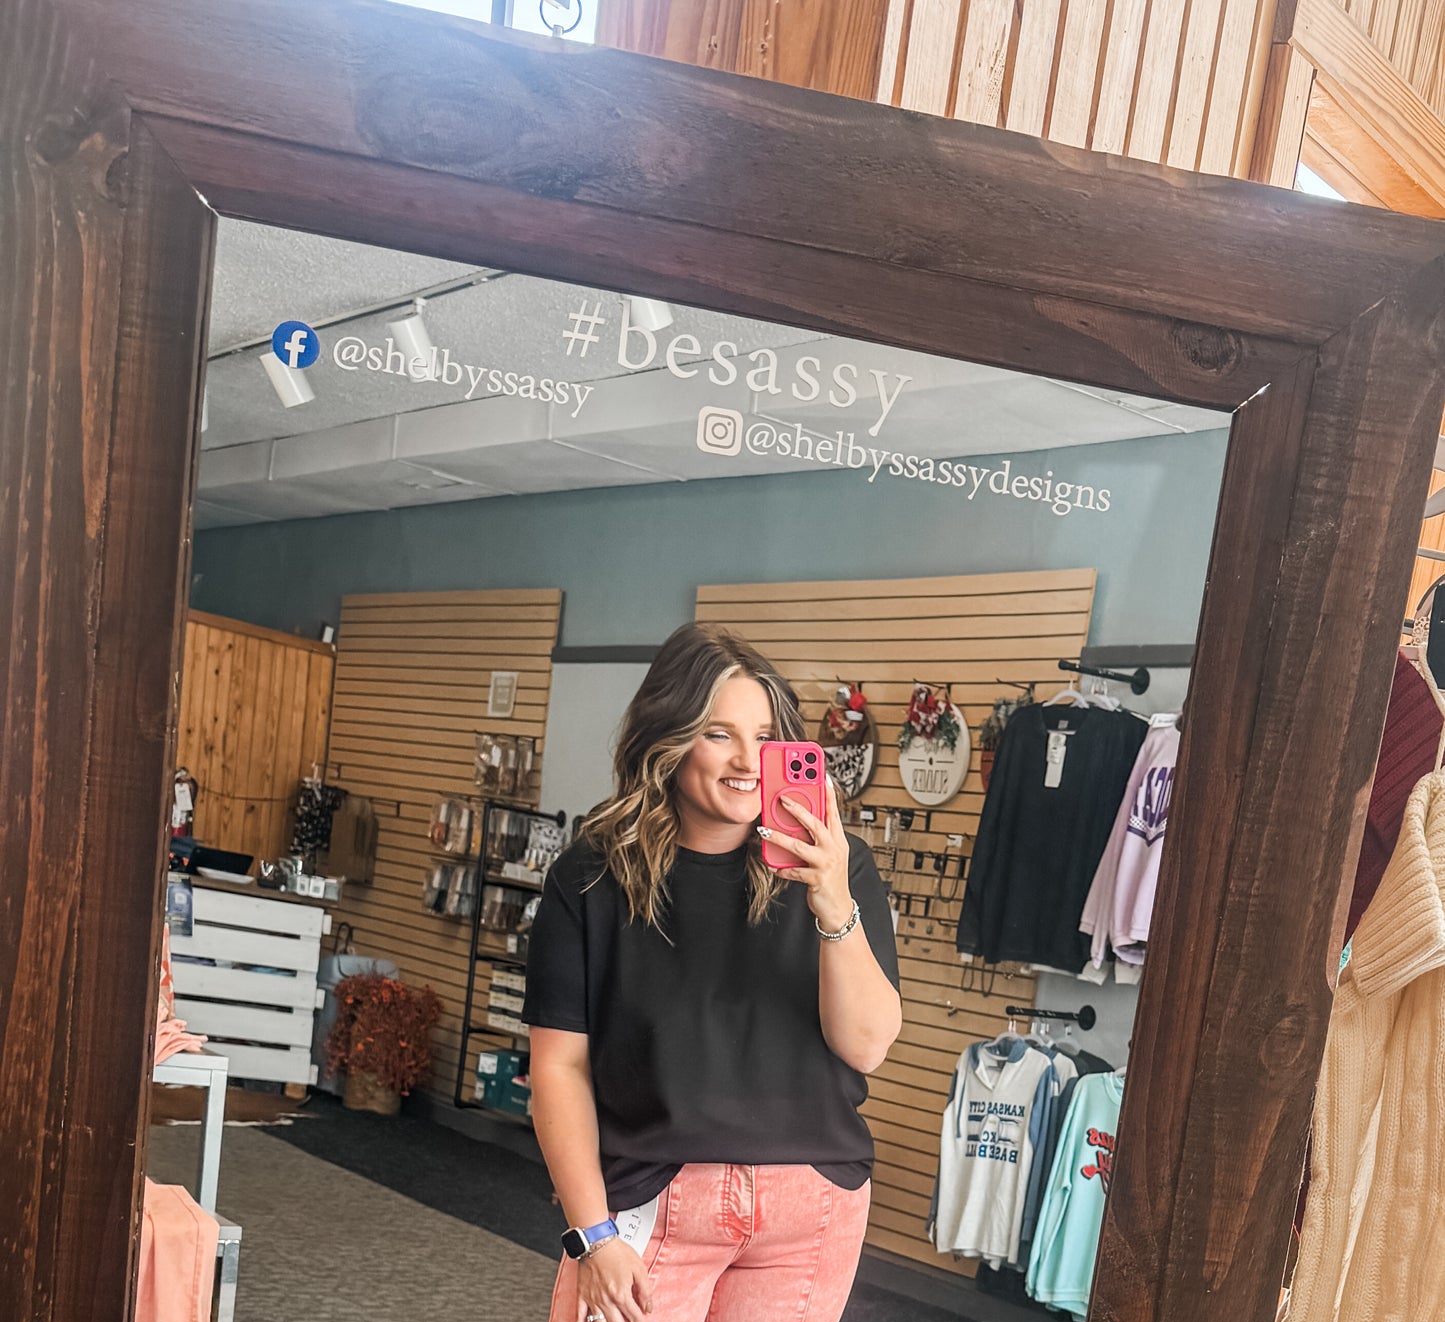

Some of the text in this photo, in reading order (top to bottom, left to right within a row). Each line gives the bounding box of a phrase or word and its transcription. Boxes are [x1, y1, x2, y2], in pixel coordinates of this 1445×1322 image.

[333, 336, 595, 418] @shelbyssassy
[562, 299, 912, 437] #besassy
[745, 422, 1111, 516] @shelbyssassydesigns
